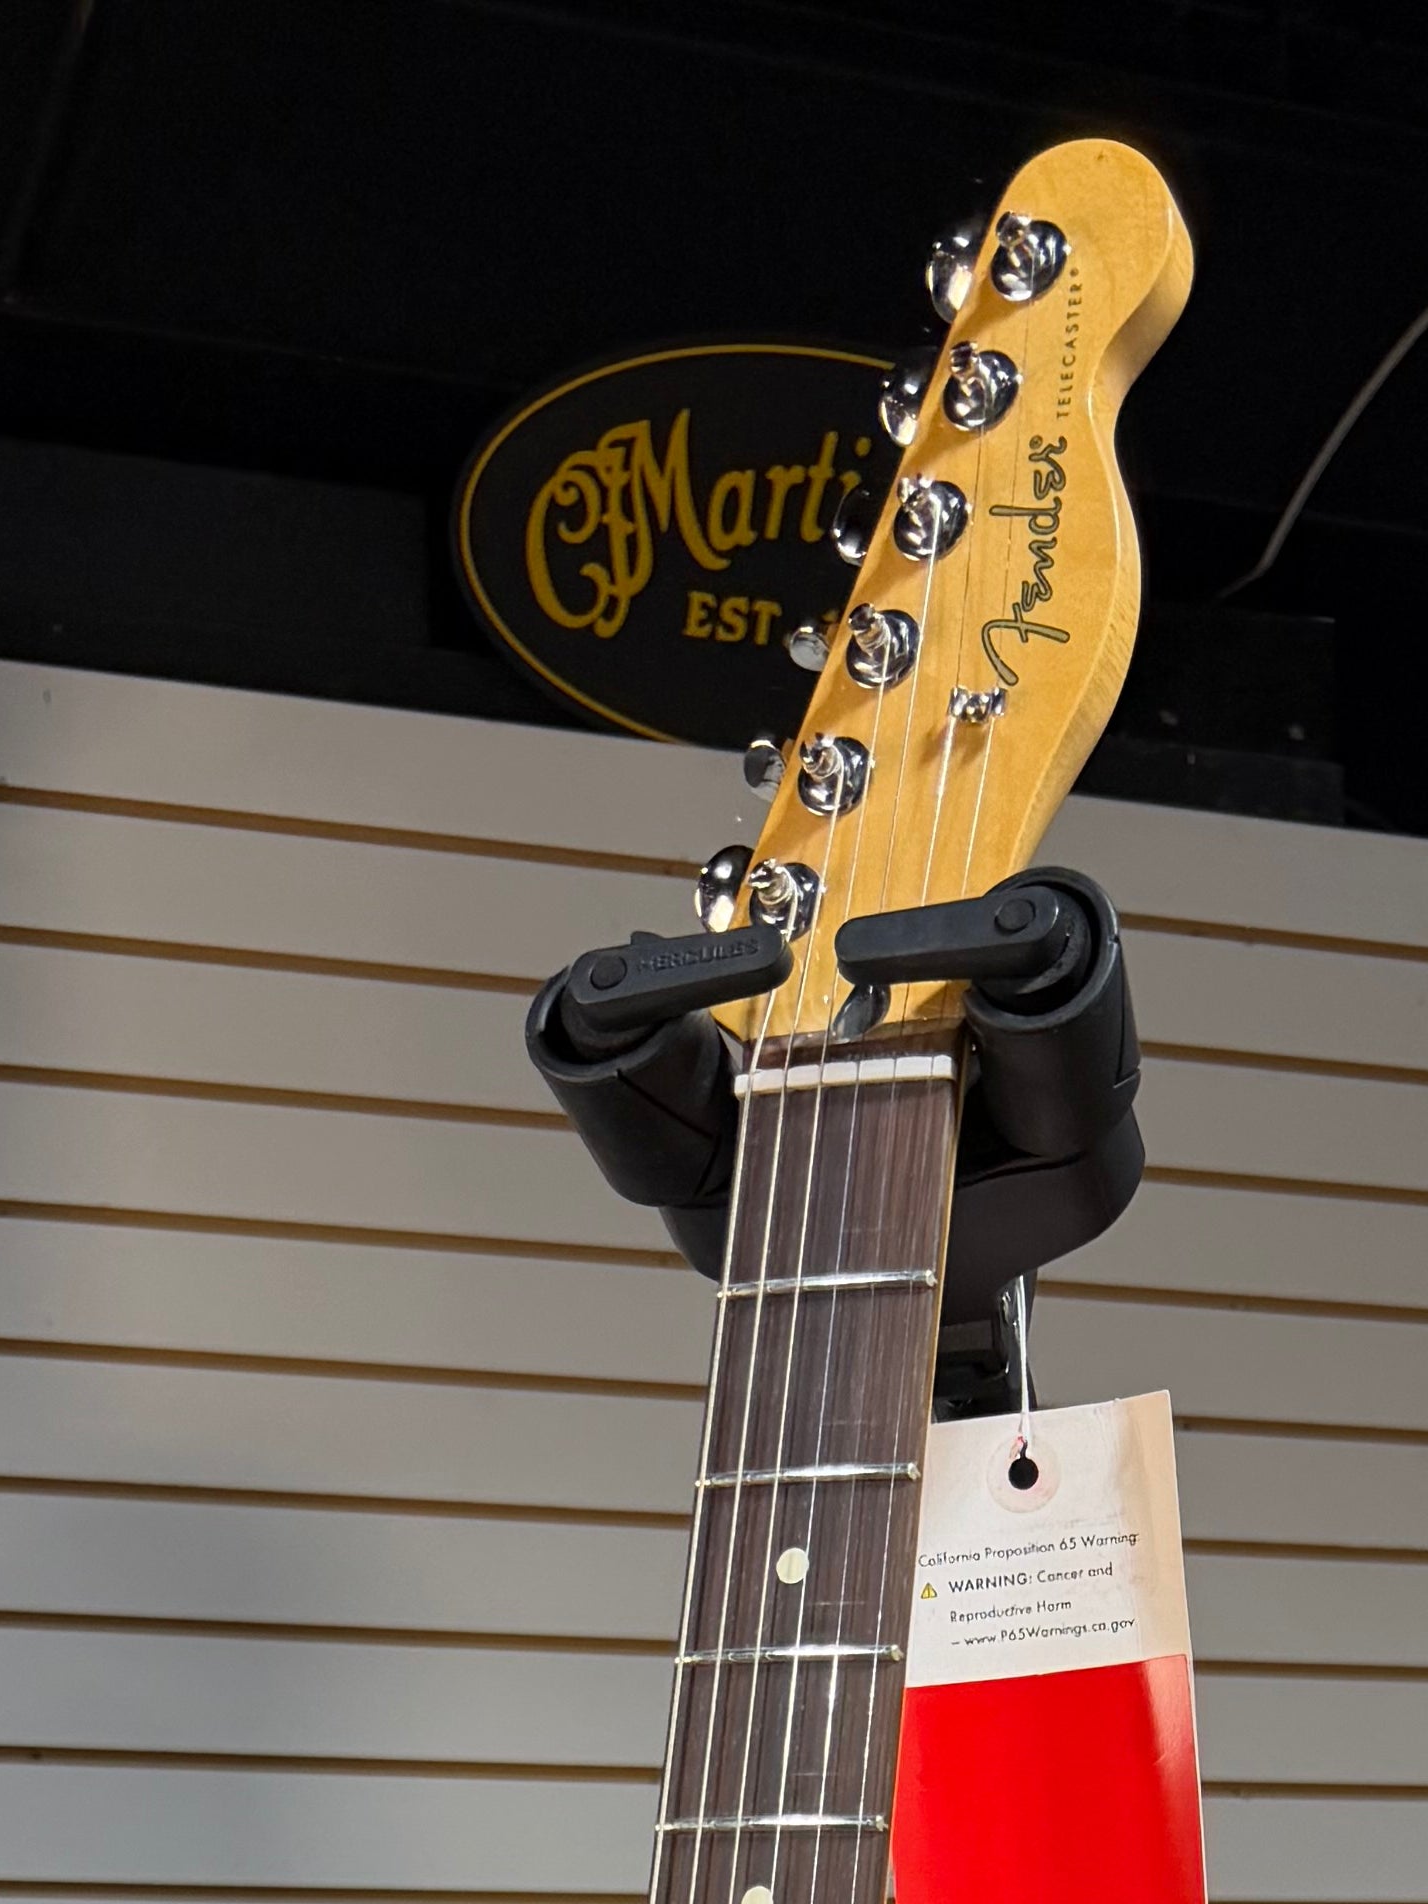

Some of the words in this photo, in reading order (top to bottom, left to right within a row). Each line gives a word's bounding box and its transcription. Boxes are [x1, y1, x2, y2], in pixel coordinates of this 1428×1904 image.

[597, 407, 871, 600] Marti
[683, 590, 782, 645] EST
[638, 938, 760, 973] HERCULES
[918, 1550, 981, 1568] California
[985, 1542, 1056, 1561] Proposition
[1059, 1536, 1077, 1551] 65
[1080, 1531, 1140, 1548] Warning
[948, 1572, 1033, 1594] WARNING:
[1037, 1569, 1084, 1584] Cancer
[1087, 1561, 1114, 1578] and
[950, 1603, 1032, 1624] Reproductive
[1037, 1600, 1072, 1614] Harm
